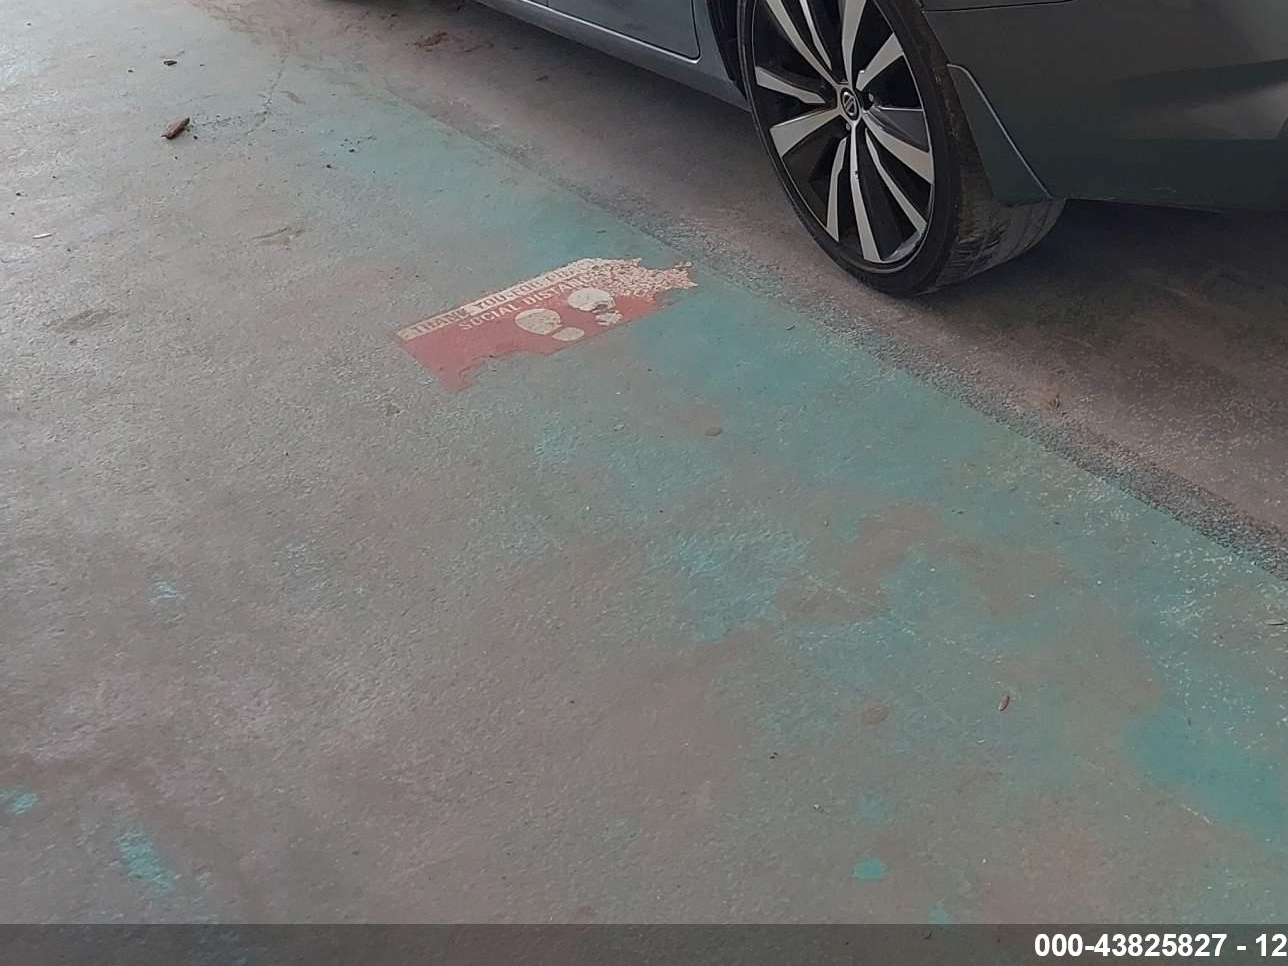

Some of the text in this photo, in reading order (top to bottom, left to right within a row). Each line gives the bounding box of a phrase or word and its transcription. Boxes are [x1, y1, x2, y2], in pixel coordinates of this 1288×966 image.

[411, 307, 468, 334] THANK
[473, 293, 507, 310] YOU
[458, 303, 522, 331] SOCIAL
